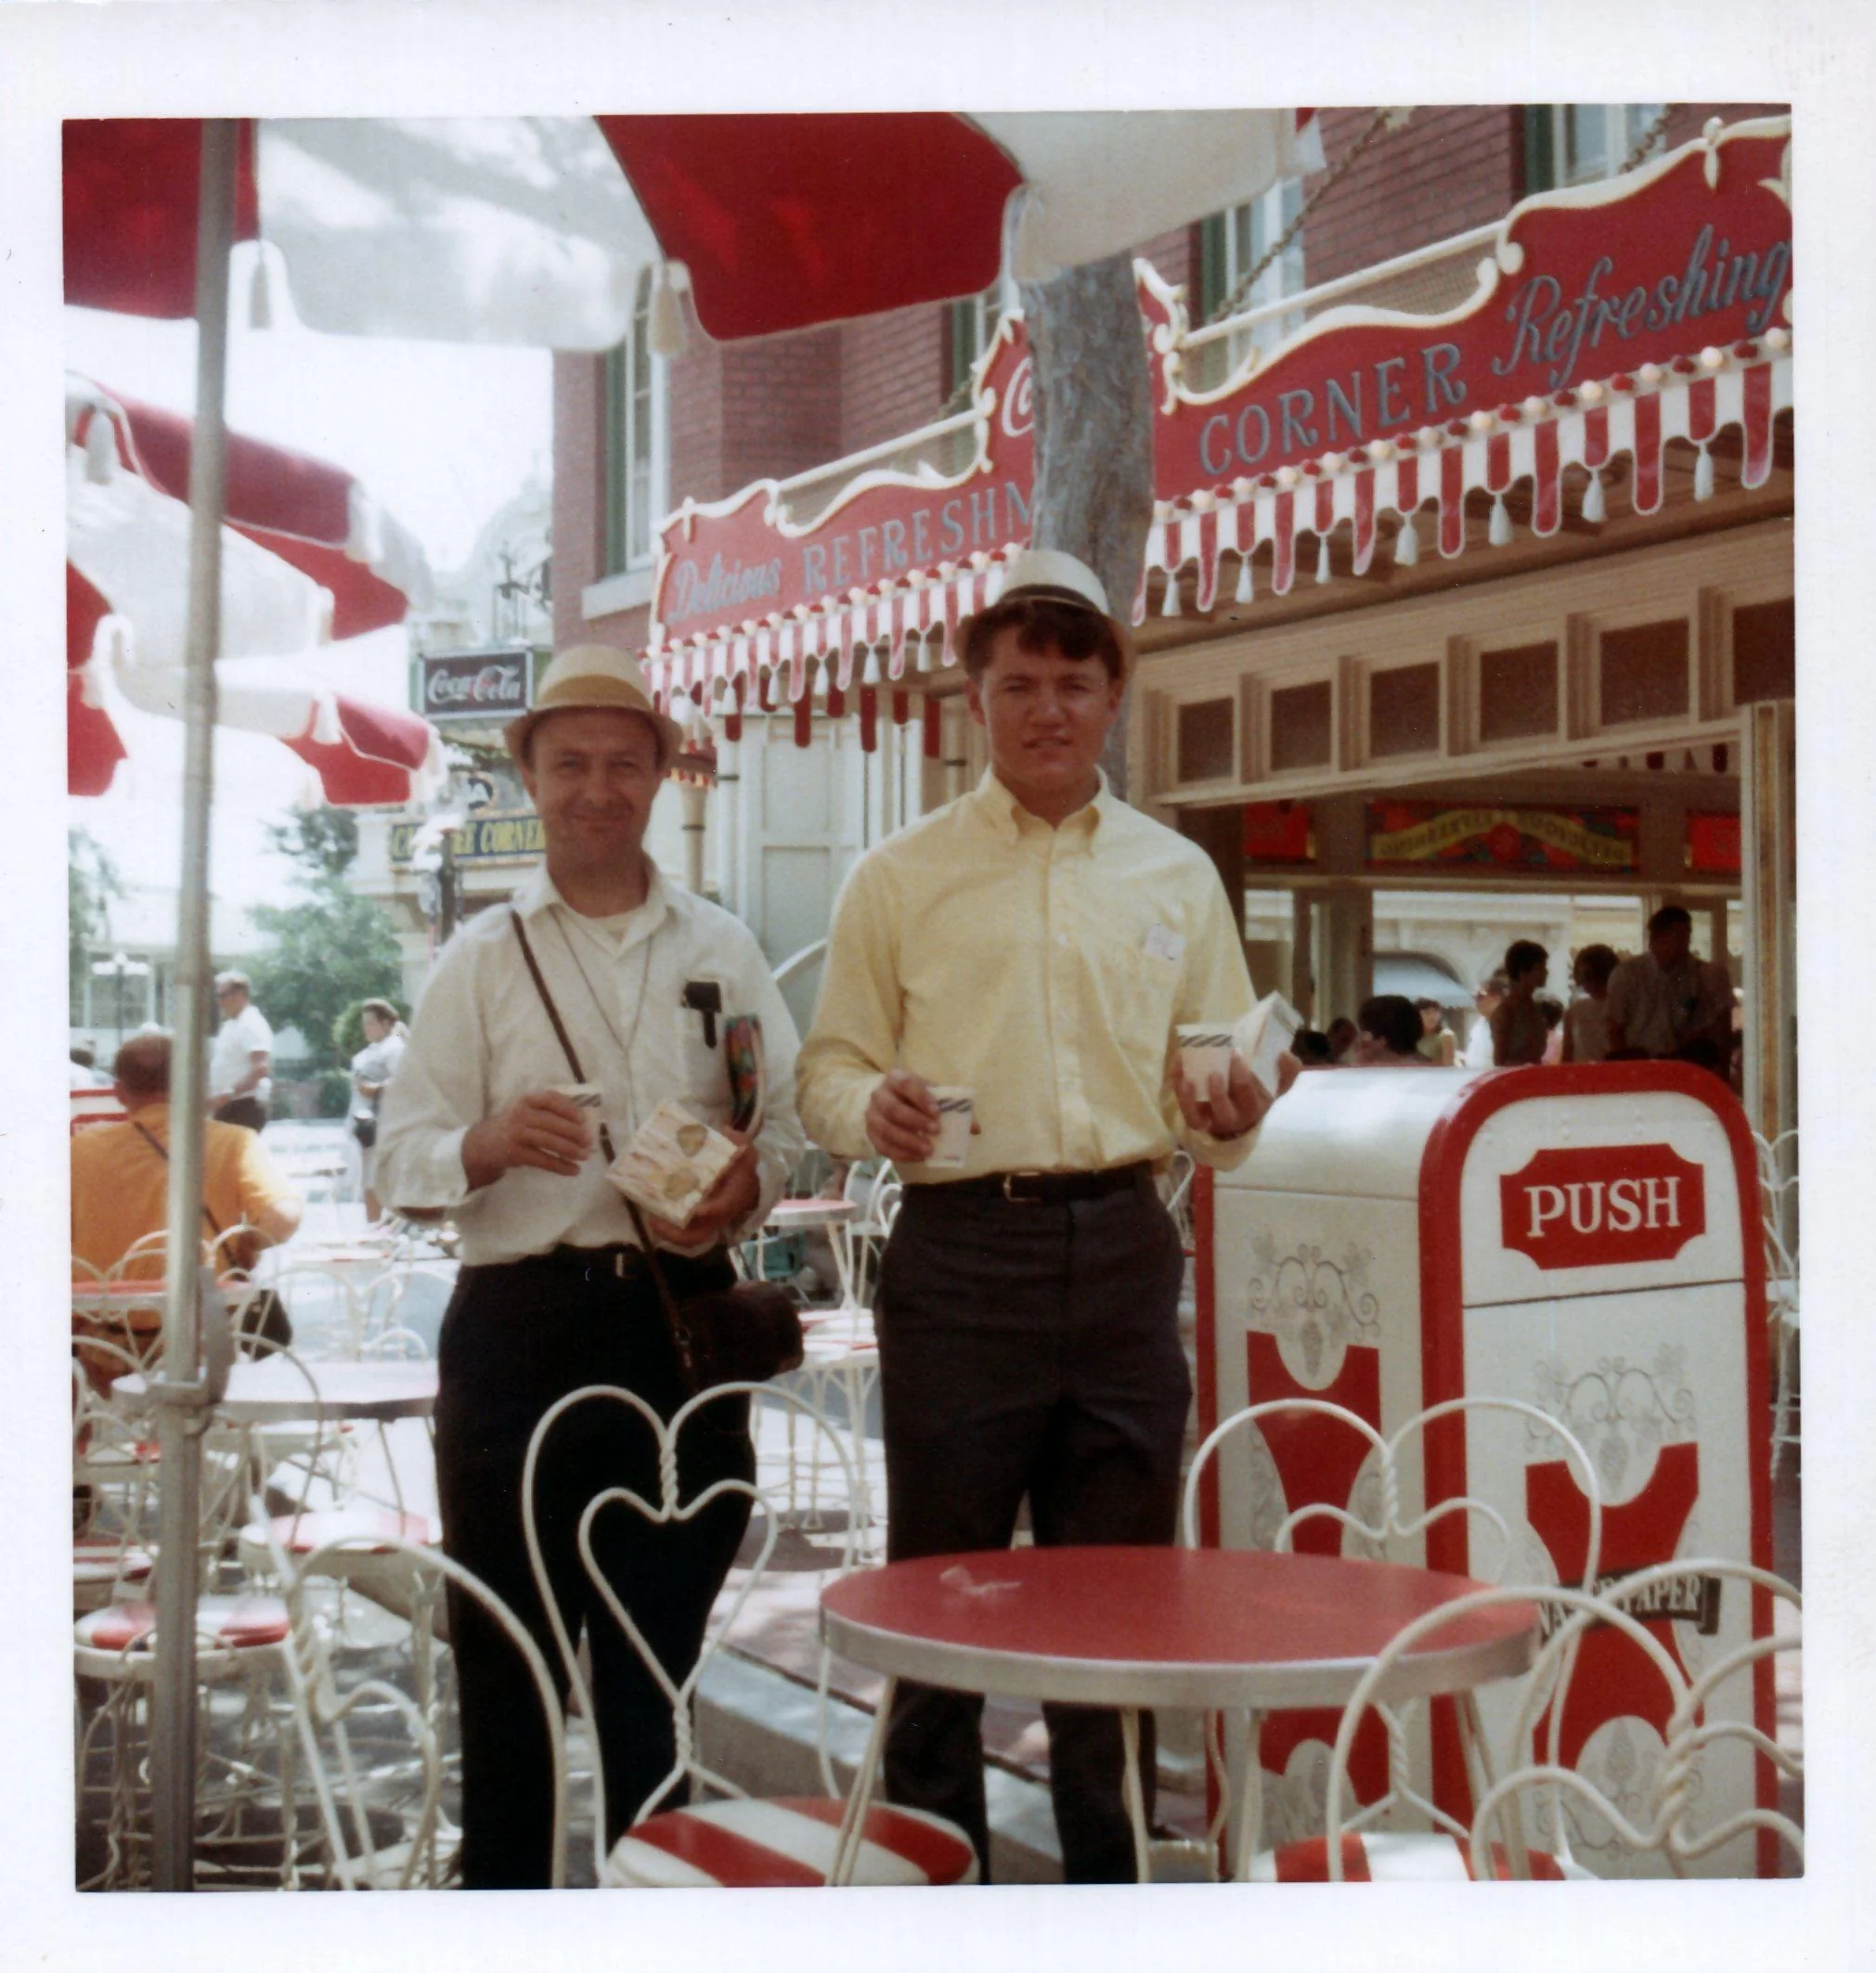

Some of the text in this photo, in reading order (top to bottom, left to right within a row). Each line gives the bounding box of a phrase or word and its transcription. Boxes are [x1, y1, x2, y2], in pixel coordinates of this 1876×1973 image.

[665, 550, 782, 625] Delicious
[1199, 342, 1468, 476] CORNER
[1489, 224, 1792, 387] Refreshing
[1523, 1176, 1681, 1238] PUSH
